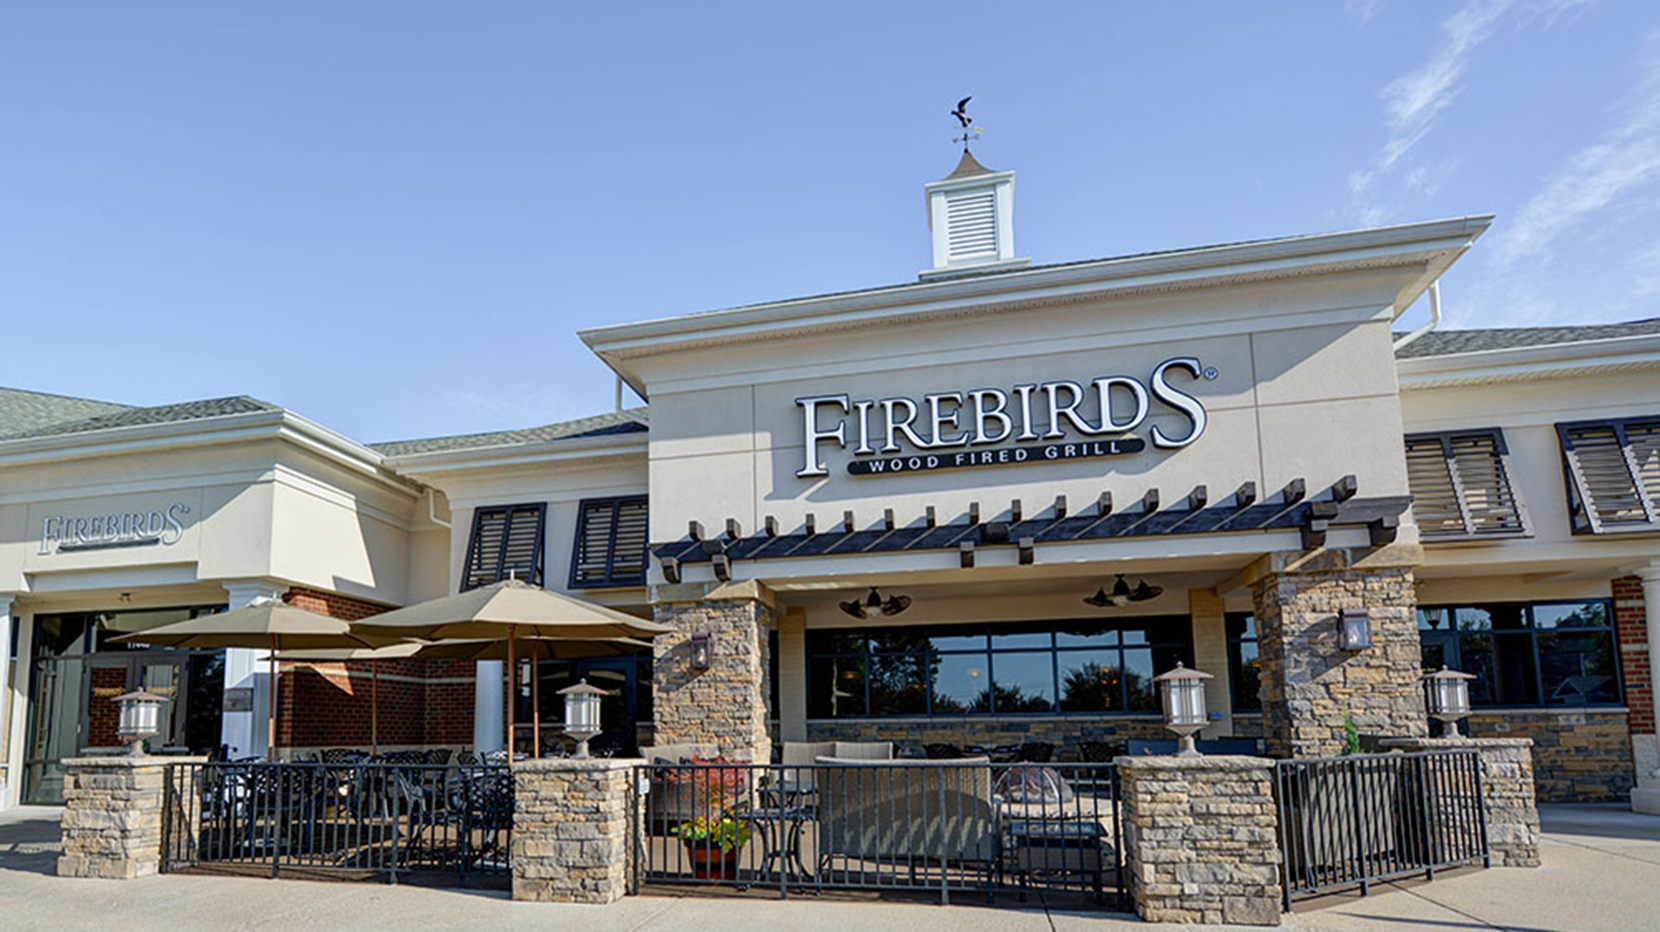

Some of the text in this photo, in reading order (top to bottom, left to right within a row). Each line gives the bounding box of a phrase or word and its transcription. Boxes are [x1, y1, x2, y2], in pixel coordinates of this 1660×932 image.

[795, 357, 1208, 478] FIREBIRDS
[869, 440, 1122, 473] WOOD FIRED GRILL
[38, 504, 184, 556] FIREBIRDS
